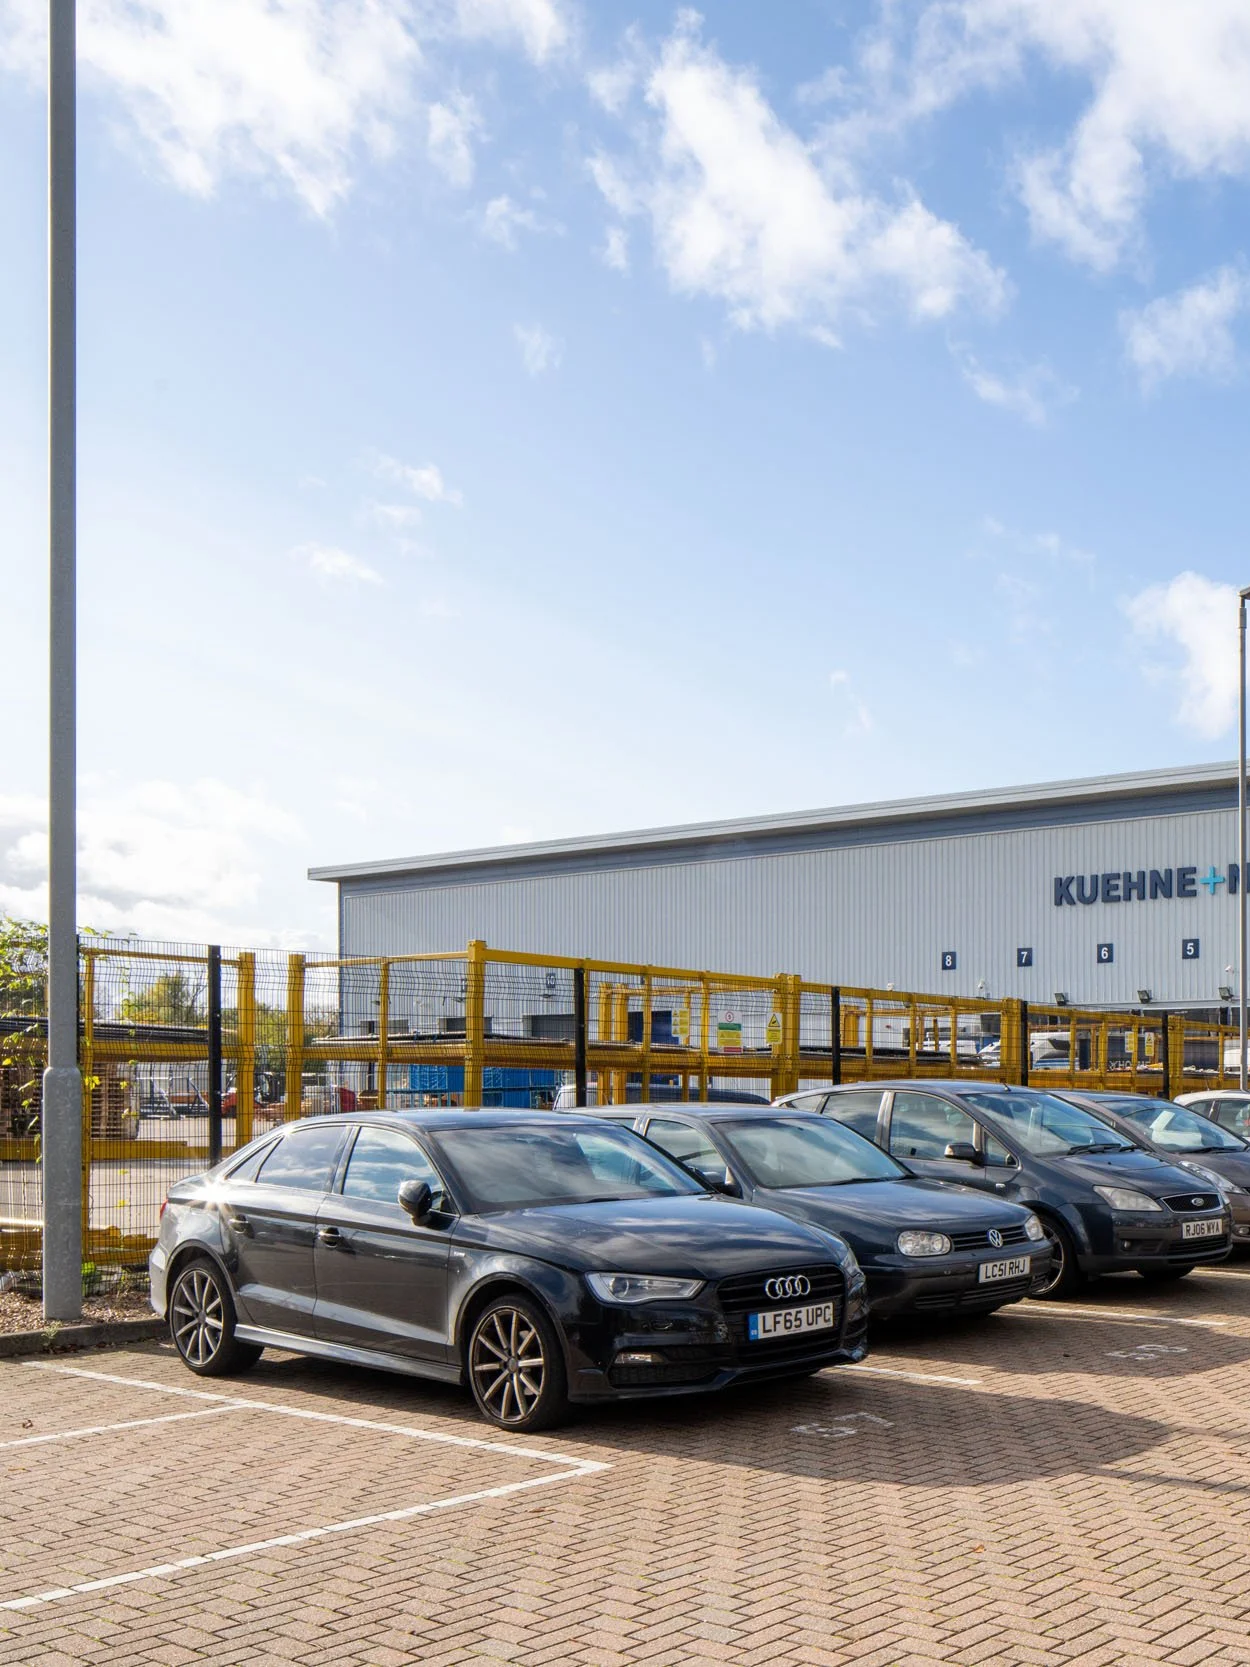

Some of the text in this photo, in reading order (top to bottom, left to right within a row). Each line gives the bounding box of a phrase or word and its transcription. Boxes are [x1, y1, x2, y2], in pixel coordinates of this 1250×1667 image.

[1101, 947, 1109, 960] 6
[1186, 942, 1195, 956] 5
[945, 954, 952, 967] 8
[1020, 951, 1028, 963] 7
[1186, 1221, 1220, 1237] RJ06 WYA
[985, 1259, 1026, 1279] LC51 RHJ
[762, 1305, 831, 1334] LF65 UPC
